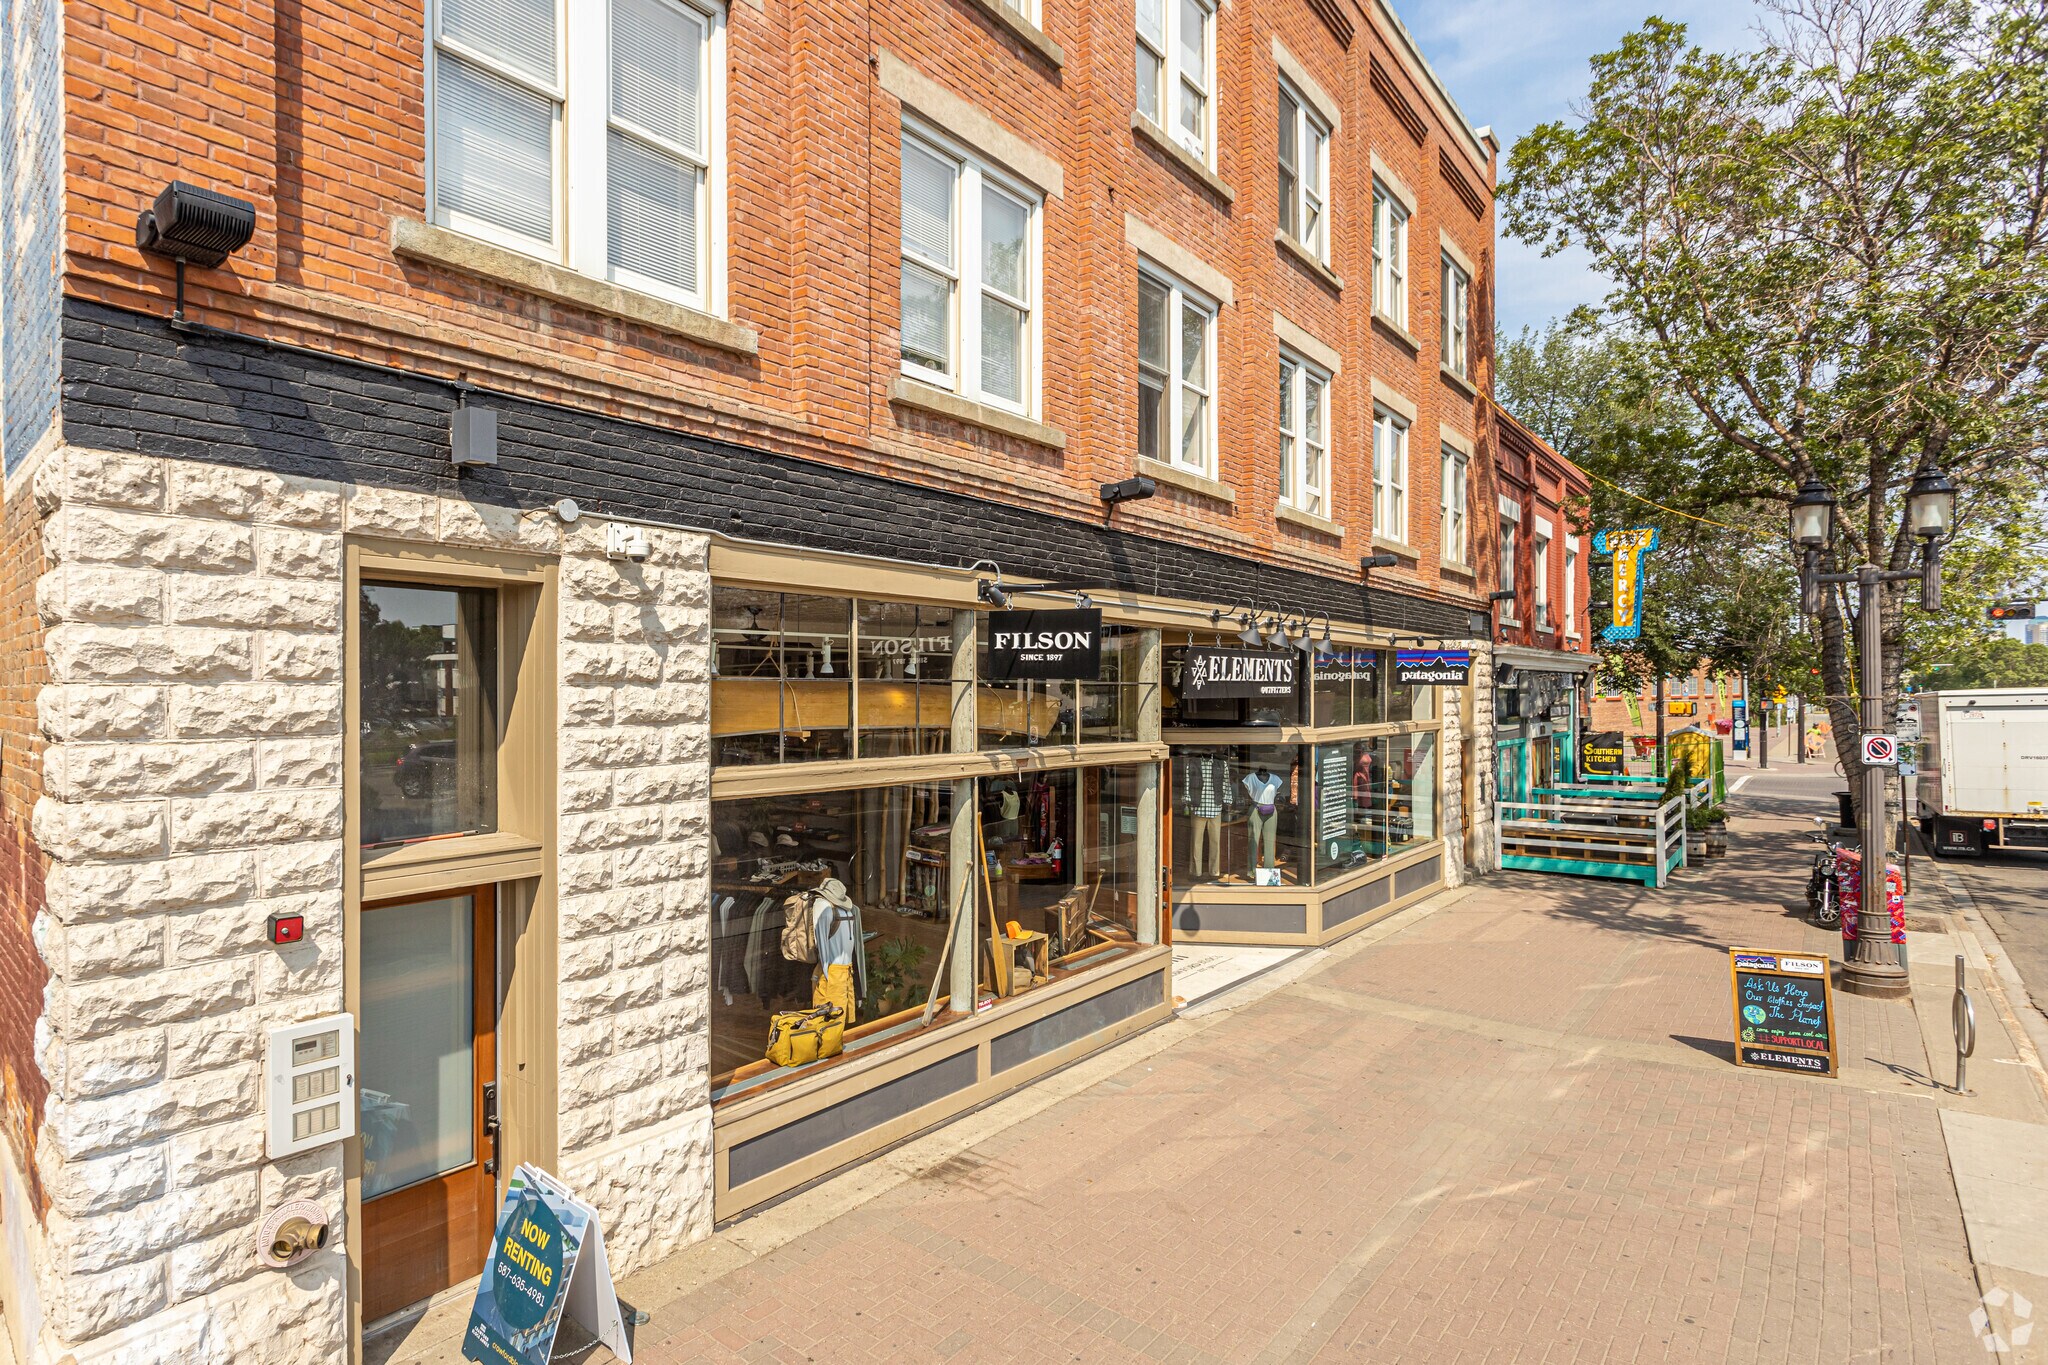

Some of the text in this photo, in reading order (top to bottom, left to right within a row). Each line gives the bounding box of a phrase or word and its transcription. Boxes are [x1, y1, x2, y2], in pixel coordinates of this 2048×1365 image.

[1617, 549, 1629, 623] MERCY
[993, 631, 1093, 650] FILSON
[1020, 653, 1063, 661] SINCE 1897
[1207, 655, 1293, 682] ELEMENTS
[1401, 669, 1464, 682] patagonia
[1583, 743, 1623, 756] SOUTHERN
[1585, 755, 1617, 763] KITCHEN
[1736, 961, 1775, 970] patagonia
[1785, 961, 1819, 969] FILSON
[1744, 977, 1764, 992] Ask
[1765, 980, 1780, 993] Us
[1745, 989, 1763, 1002] Our
[1768, 1005, 1785, 1019] The
[1760, 1052, 1822, 1067] ELEMENTS
[520, 1217, 551, 1251] NOW
[503, 1235, 553, 1287] RENTING
[497, 1261, 545, 1308] 587-635-4981
